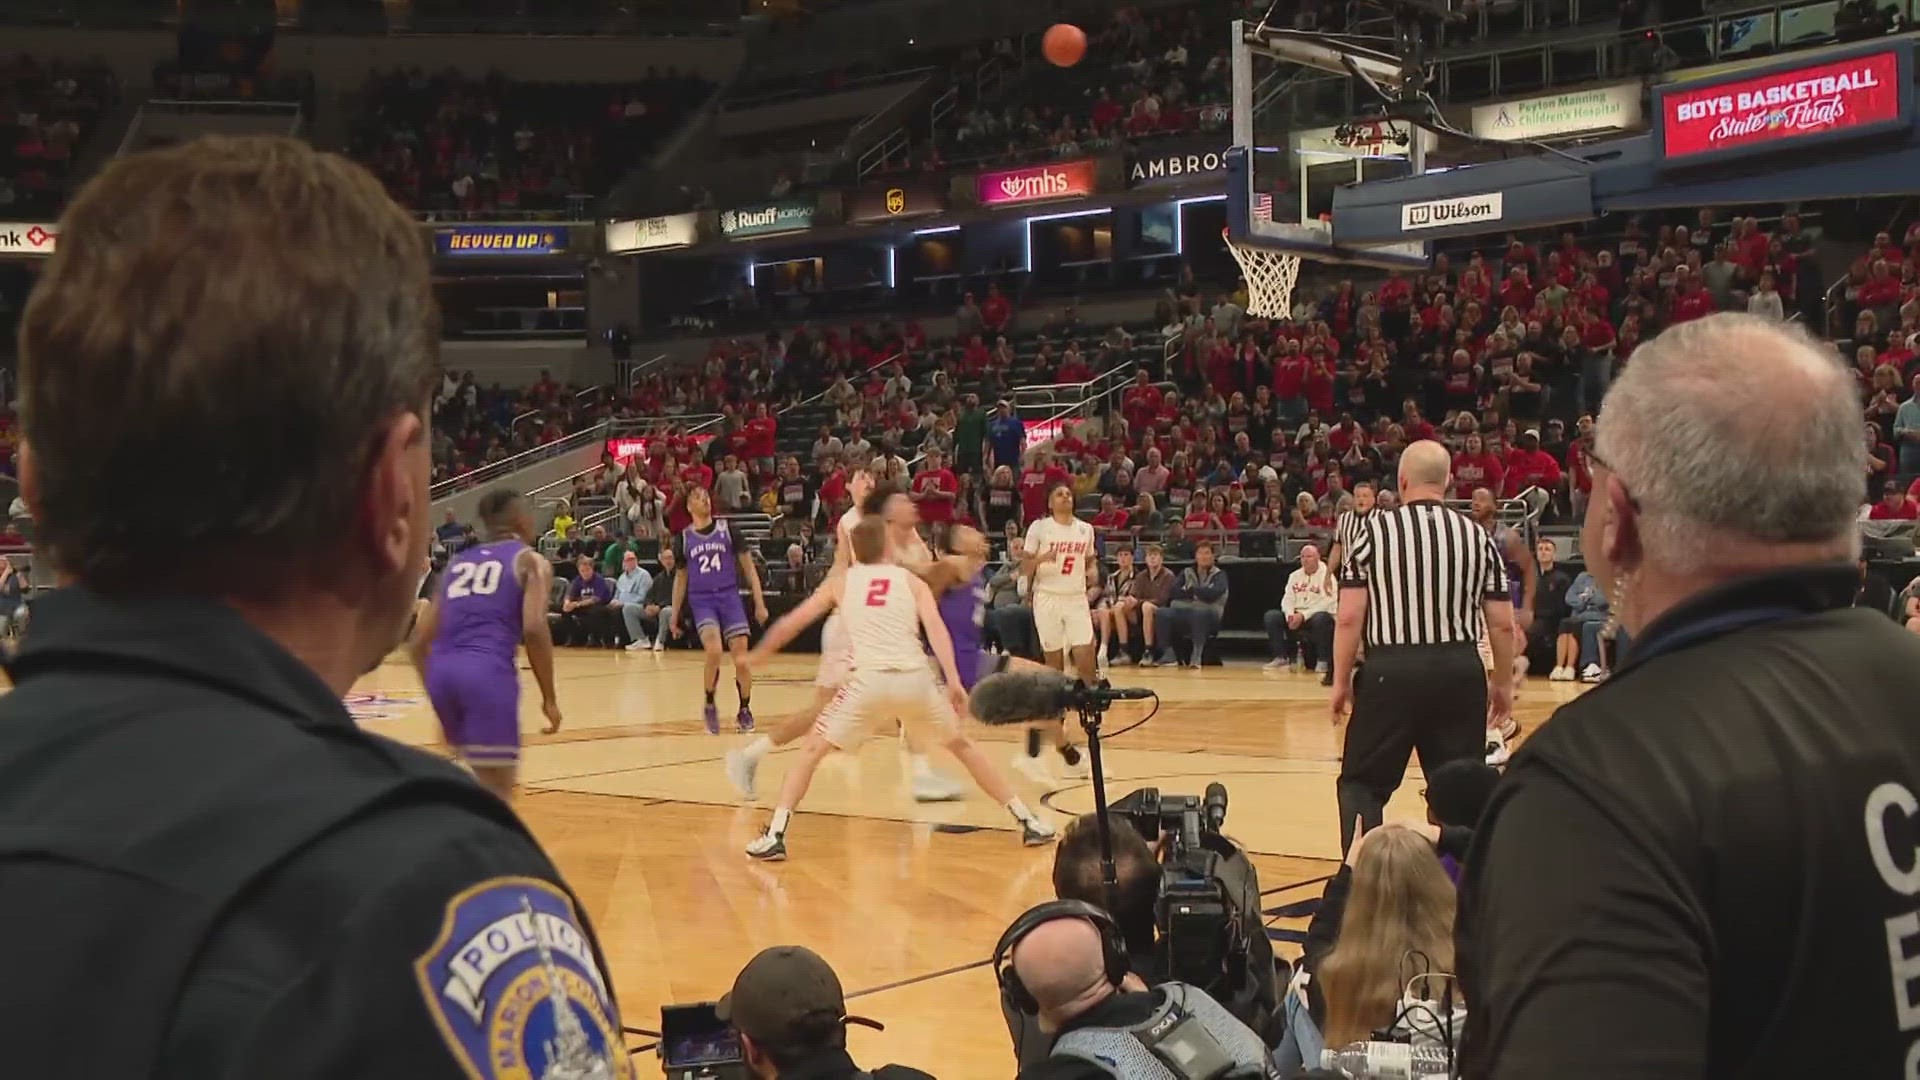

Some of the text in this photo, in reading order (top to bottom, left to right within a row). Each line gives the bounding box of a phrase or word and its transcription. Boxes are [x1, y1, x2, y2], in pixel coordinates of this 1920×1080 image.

[1518, 92, 1607, 112] Peyton Manning
[1678, 95, 1733, 122] BOYS
[1738, 68, 1878, 111] BASKETBALL
[1518, 104, 1620, 126] Children's Hospital
[1709, 109, 1767, 141] State
[1785, 94, 1845, 128] Finals
[1026, 168, 1068, 196] mhs
[738, 207, 777, 228] Ruoff
[1433, 201, 1491, 220] Wilson
[450, 232, 538, 250] REVVED UP
[1050, 541, 1086, 555] TIGERS
[699, 553, 721, 575] 24
[1061, 556, 1075, 575] 5
[447, 560, 503, 599] 20
[866, 578, 890, 606] 2
